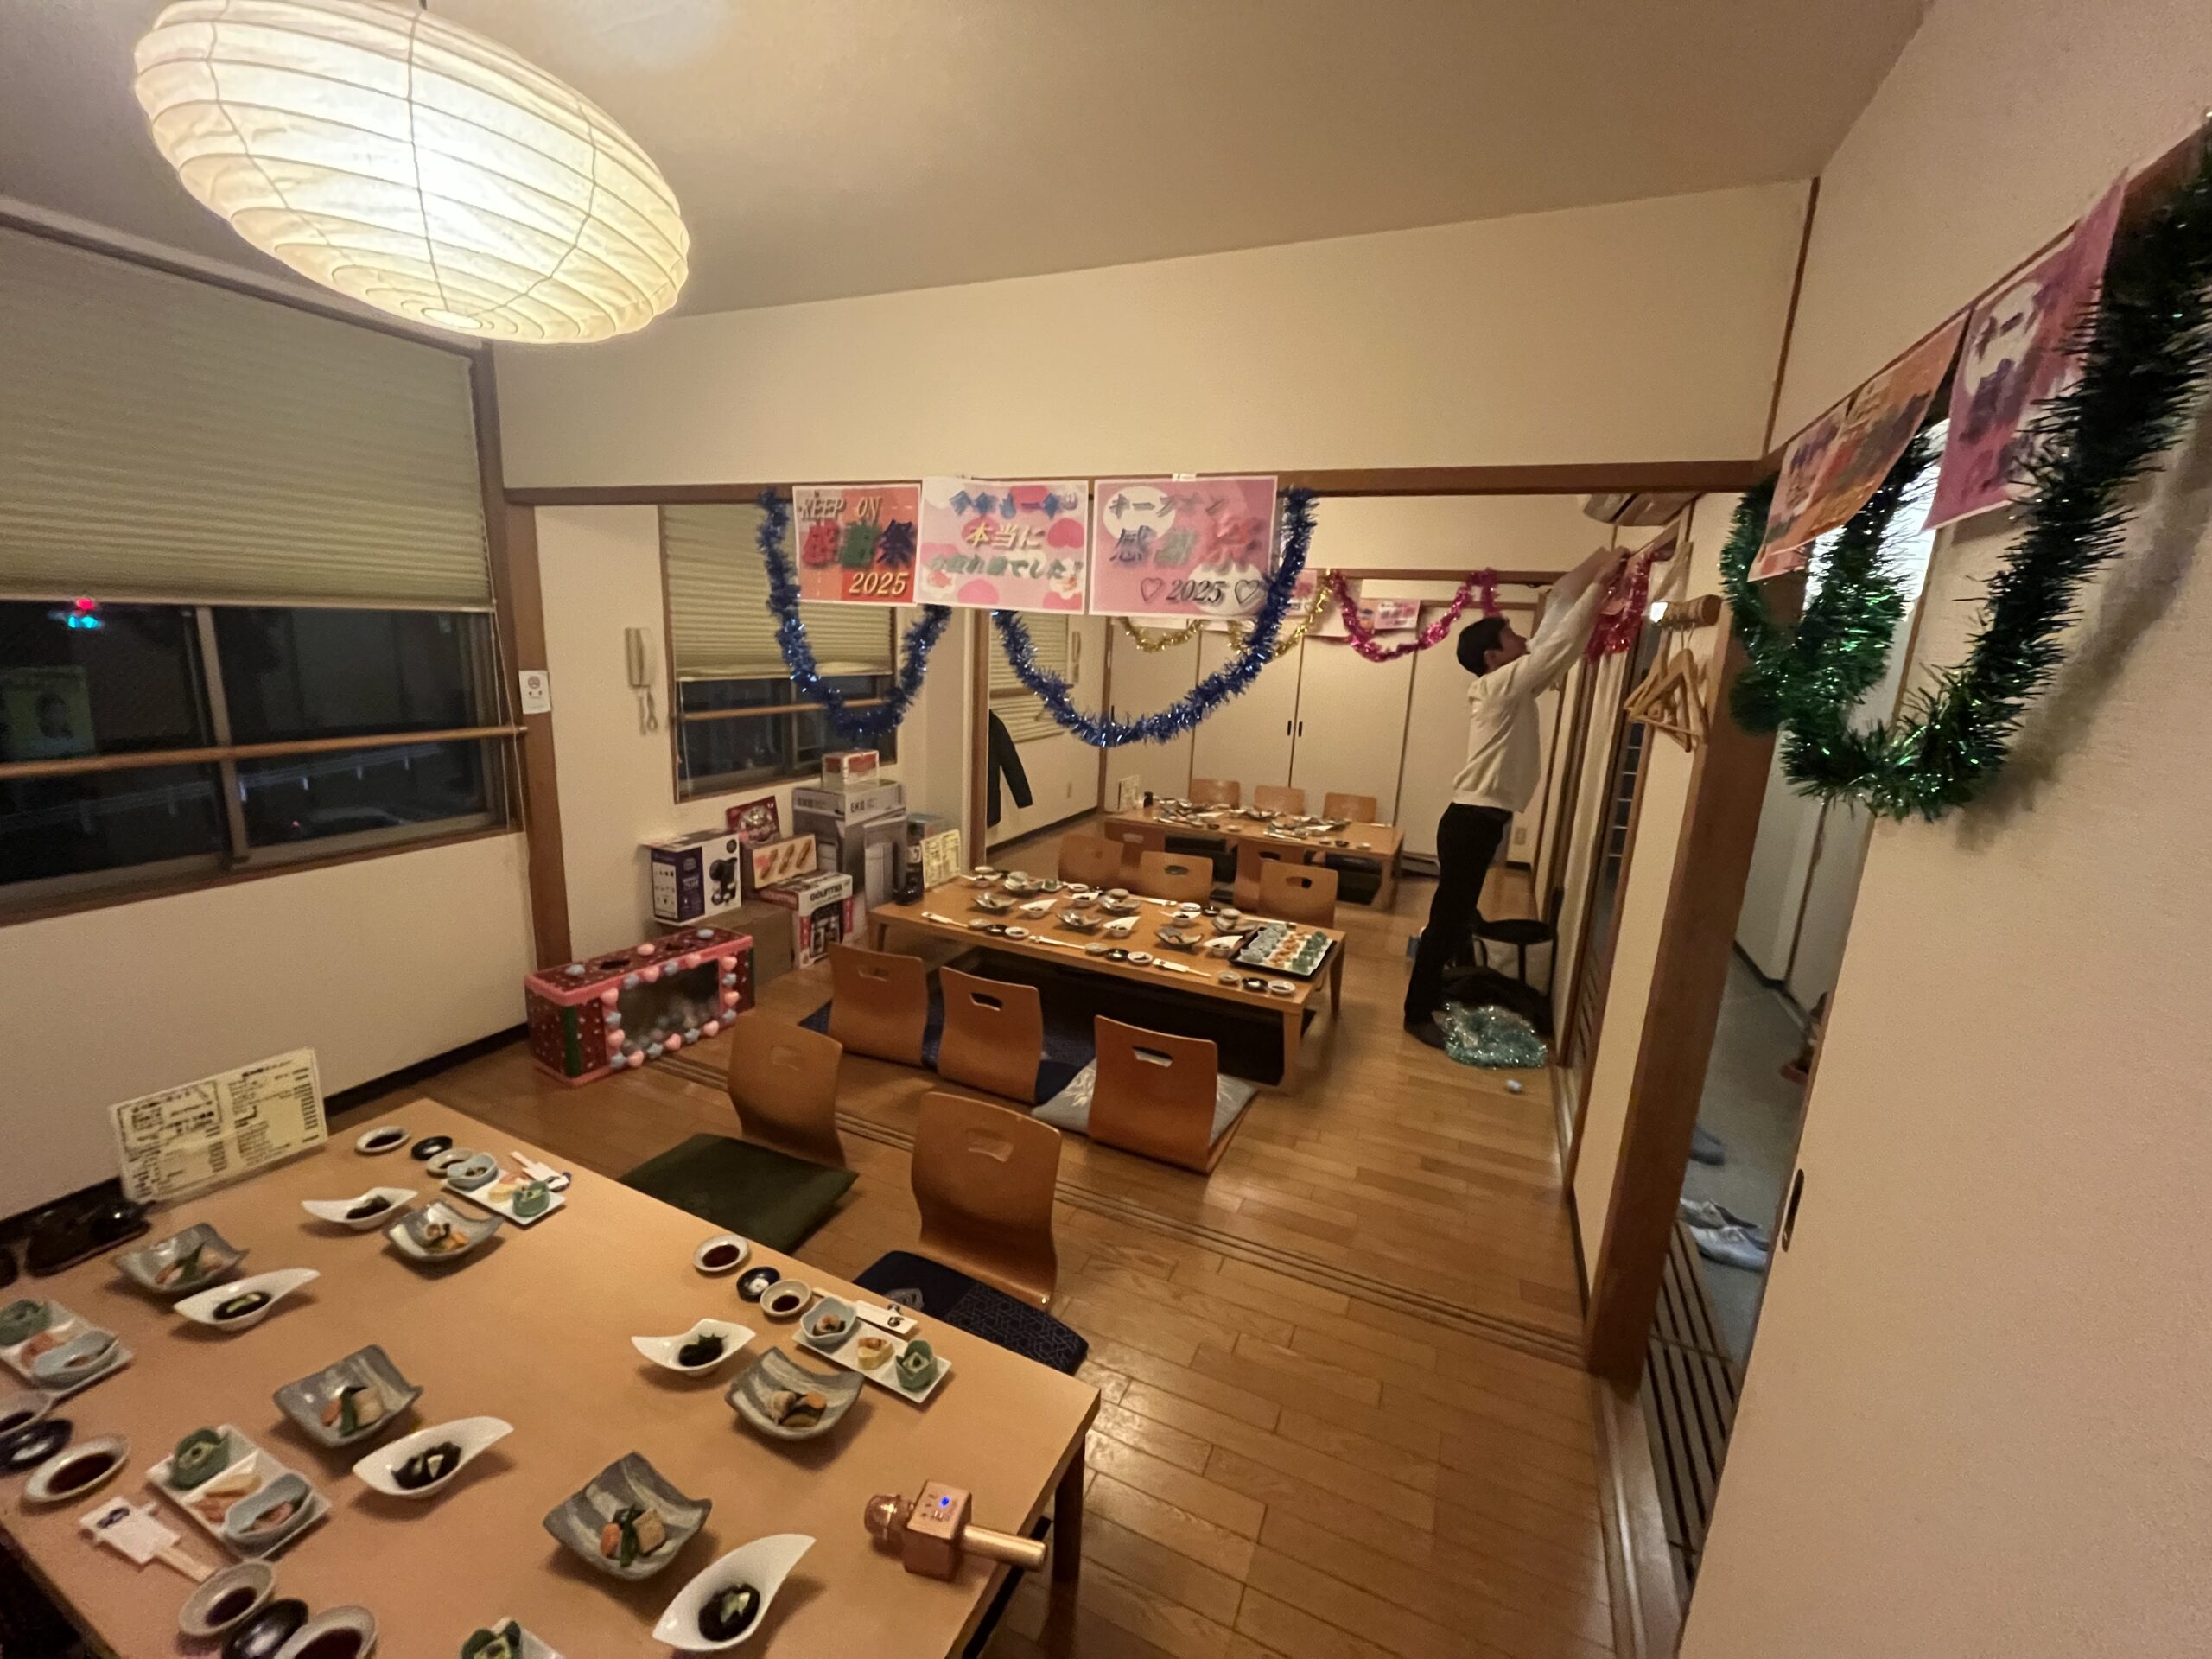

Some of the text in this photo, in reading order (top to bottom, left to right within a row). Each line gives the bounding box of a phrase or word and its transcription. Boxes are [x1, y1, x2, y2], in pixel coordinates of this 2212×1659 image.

[799, 496, 882, 520] KEEP ON
[966, 523, 1046, 550] 本当に
[849, 571, 910, 595] 2025
[1166, 579, 1228, 603] 2025
